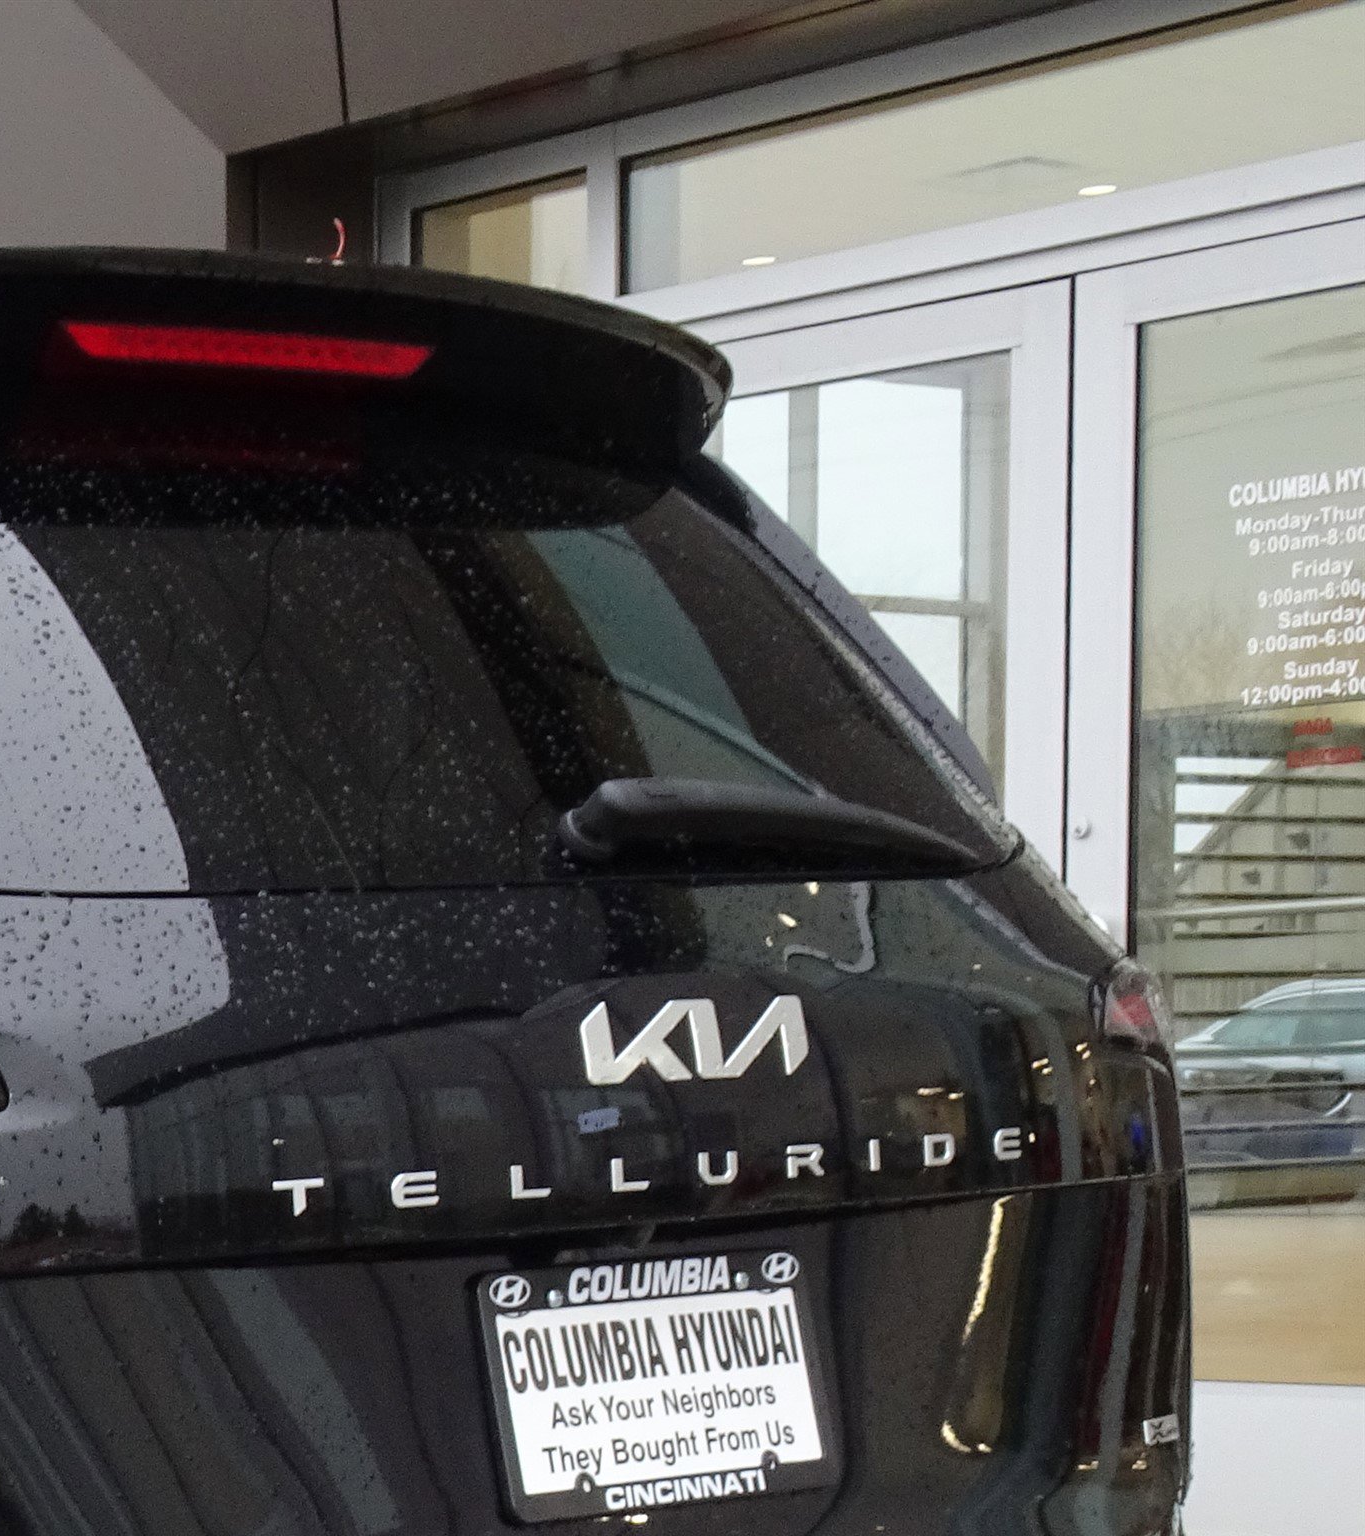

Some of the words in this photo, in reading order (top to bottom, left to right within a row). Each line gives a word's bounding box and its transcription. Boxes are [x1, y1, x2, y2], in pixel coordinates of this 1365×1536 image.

[1229, 472, 1330, 507] COLUMBIA
[1335, 466, 1365, 492] HY
[1291, 559, 1354, 579] Friday
[1258, 578, 1365, 608] 9:00am-6:00
[1278, 605, 1365, 629] Saturday
[1284, 657, 1359, 680] Sunday
[579, 994, 810, 1086] KIA
[272, 1126, 1026, 1218] TELLURIDE
[569, 1256, 730, 1303] COLUMBIA
[502, 1316, 668, 1393] COLUMBIA
[669, 1304, 799, 1375] HYUNDAI
[551, 1398, 599, 1429] Ask
[599, 1395, 654, 1423] Your
[661, 1383, 777, 1418] Neighbors
[542, 1445, 603, 1476] They
[611, 1431, 699, 1466] Bought
[704, 1426, 762, 1453] From
[765, 1420, 796, 1447] Us
[605, 1468, 768, 1511] CINCINNATI
